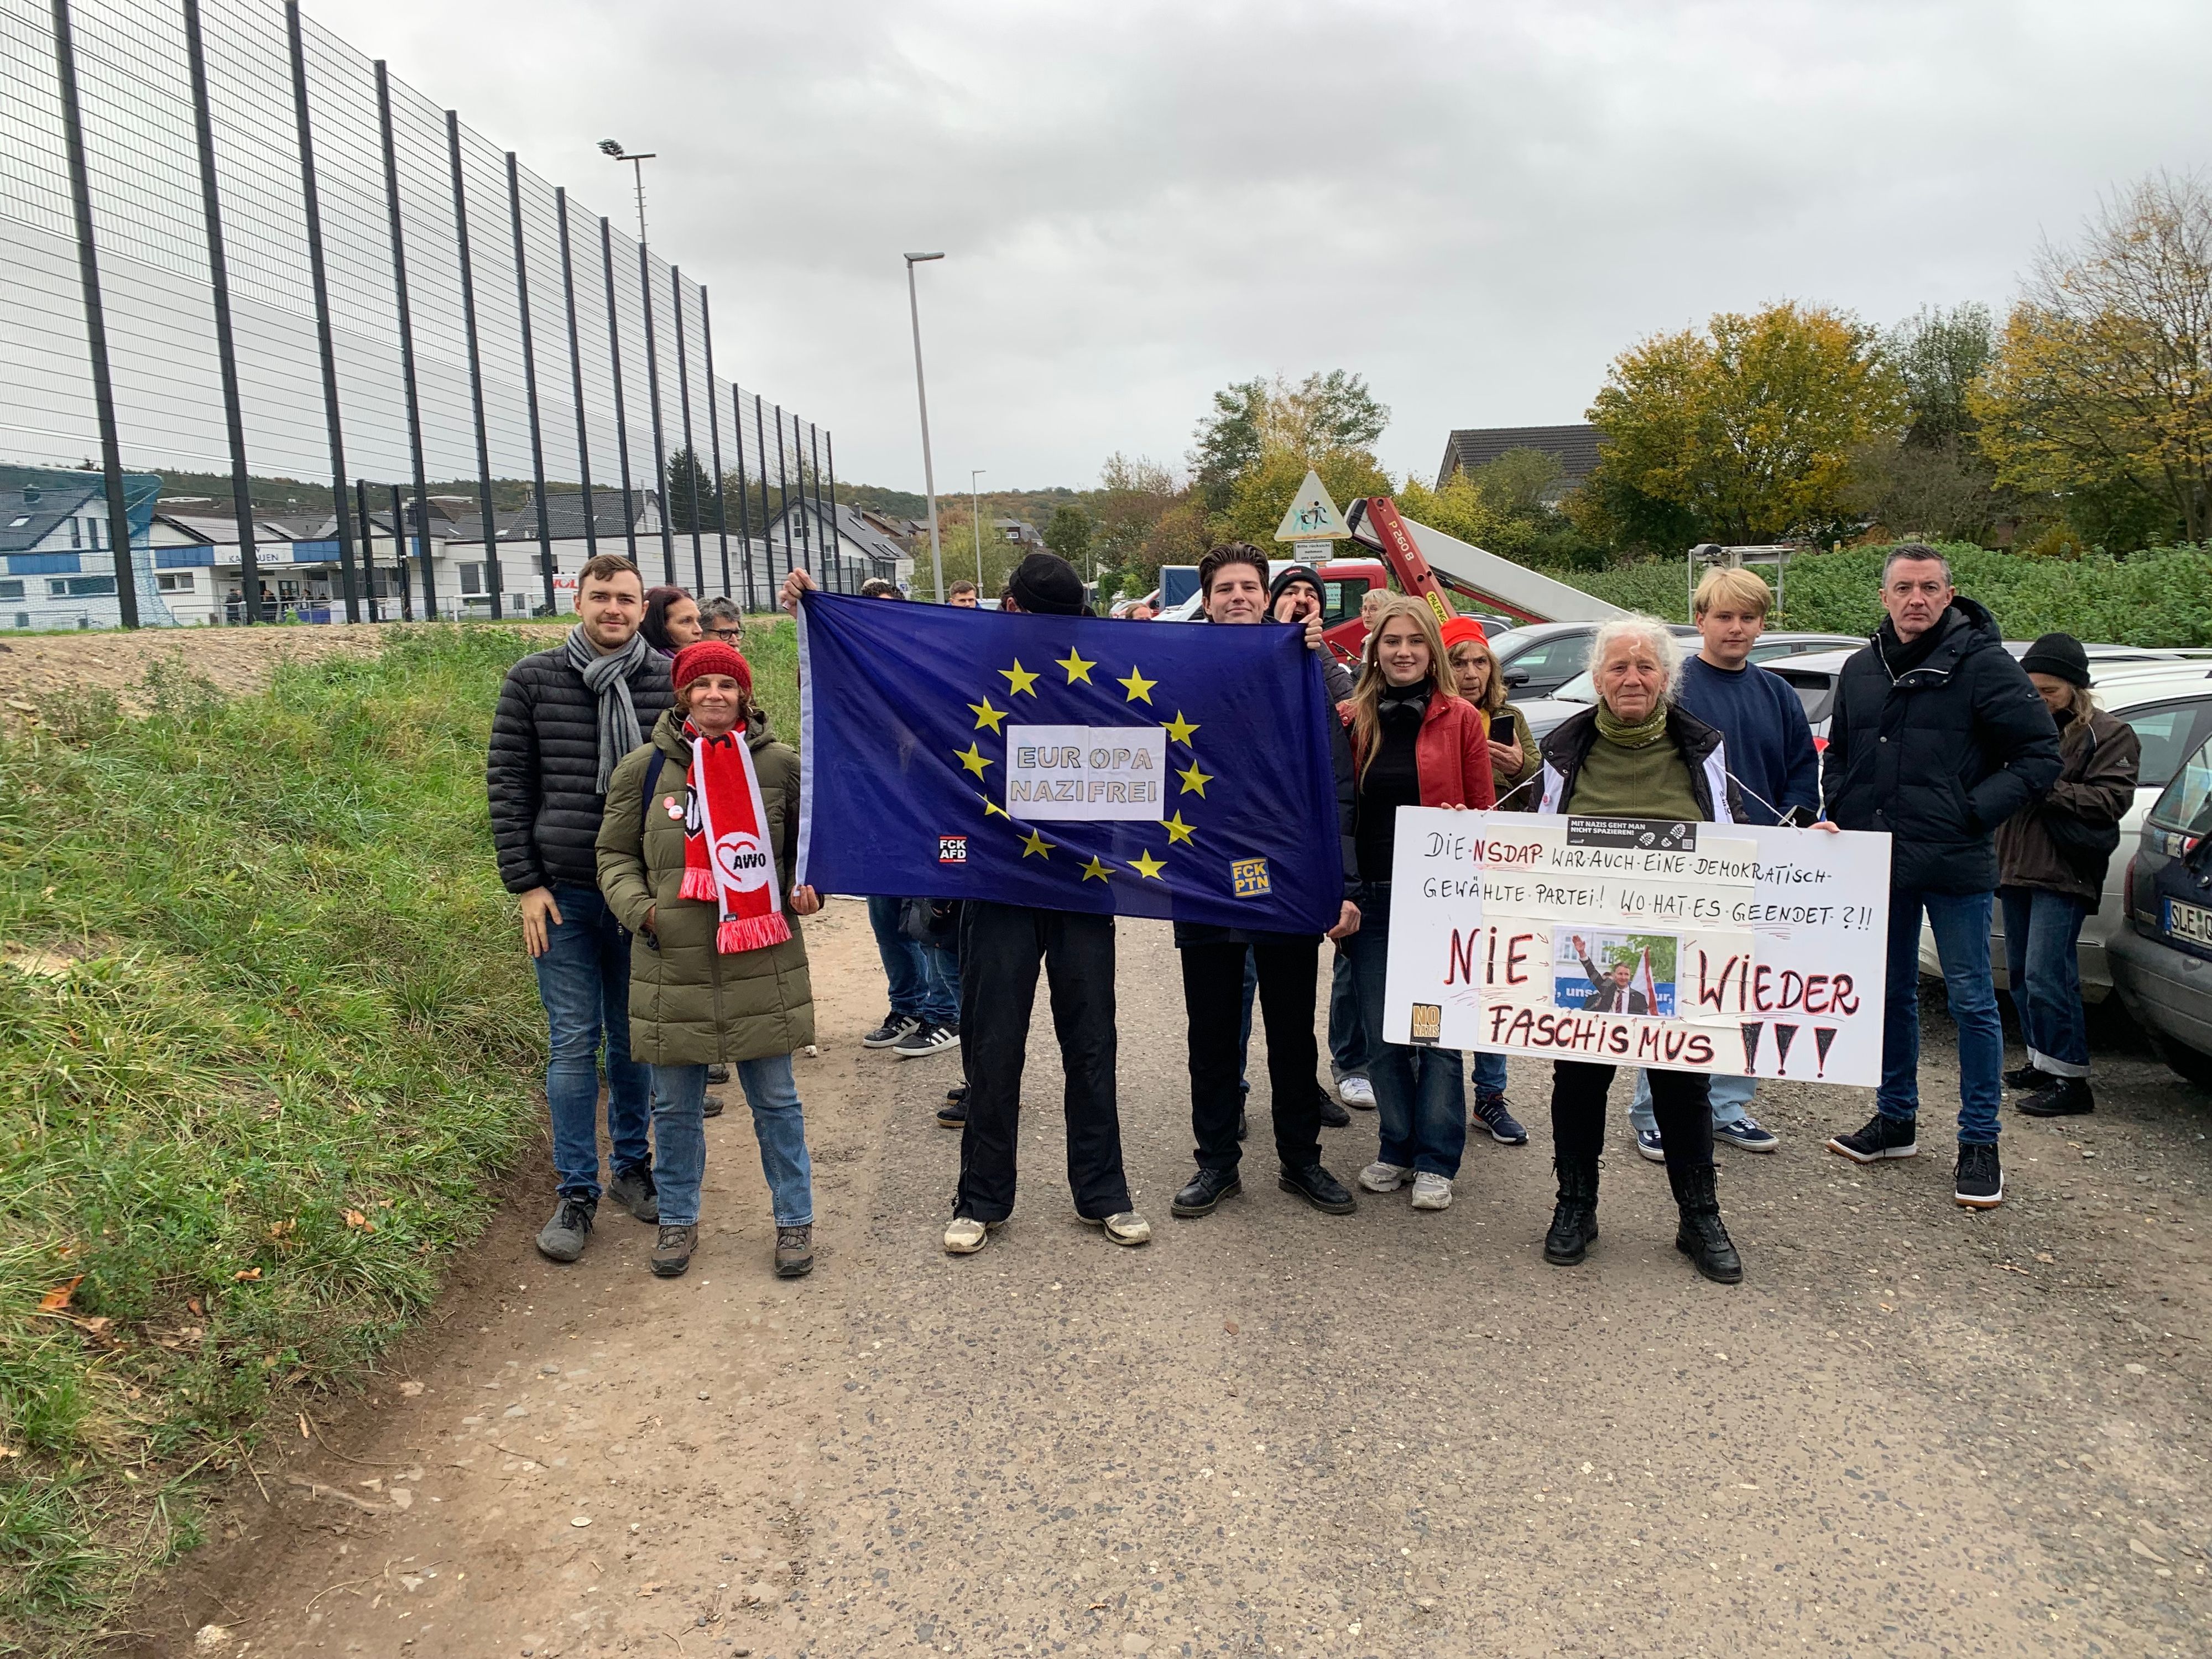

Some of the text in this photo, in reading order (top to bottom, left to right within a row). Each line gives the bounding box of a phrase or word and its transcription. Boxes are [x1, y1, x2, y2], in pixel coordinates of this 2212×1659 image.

[1389, 520, 1415, 561] P 260 B
[940, 840, 966, 849] FCK
[733, 853, 766, 870] AWO
[940, 849, 966, 858] AFD
[1552, 848, 1585, 868] WAR
[1589, 851, 1634, 870] AUCH
[1233, 863, 1266, 879] FCK
[1235, 875, 1269, 892] PTN
[1424, 876, 1525, 901] GEWÄHLTE
[1621, 889, 1645, 911] WO
[1654, 894, 1688, 916] HAT
[1694, 898, 1720, 918] ES
[1733, 902, 1834, 925] GEENDET
[2172, 905, 2195, 935] SLE
[1413, 1006, 1440, 1026] NO
[1413, 1025, 1440, 1037] NAZIS
